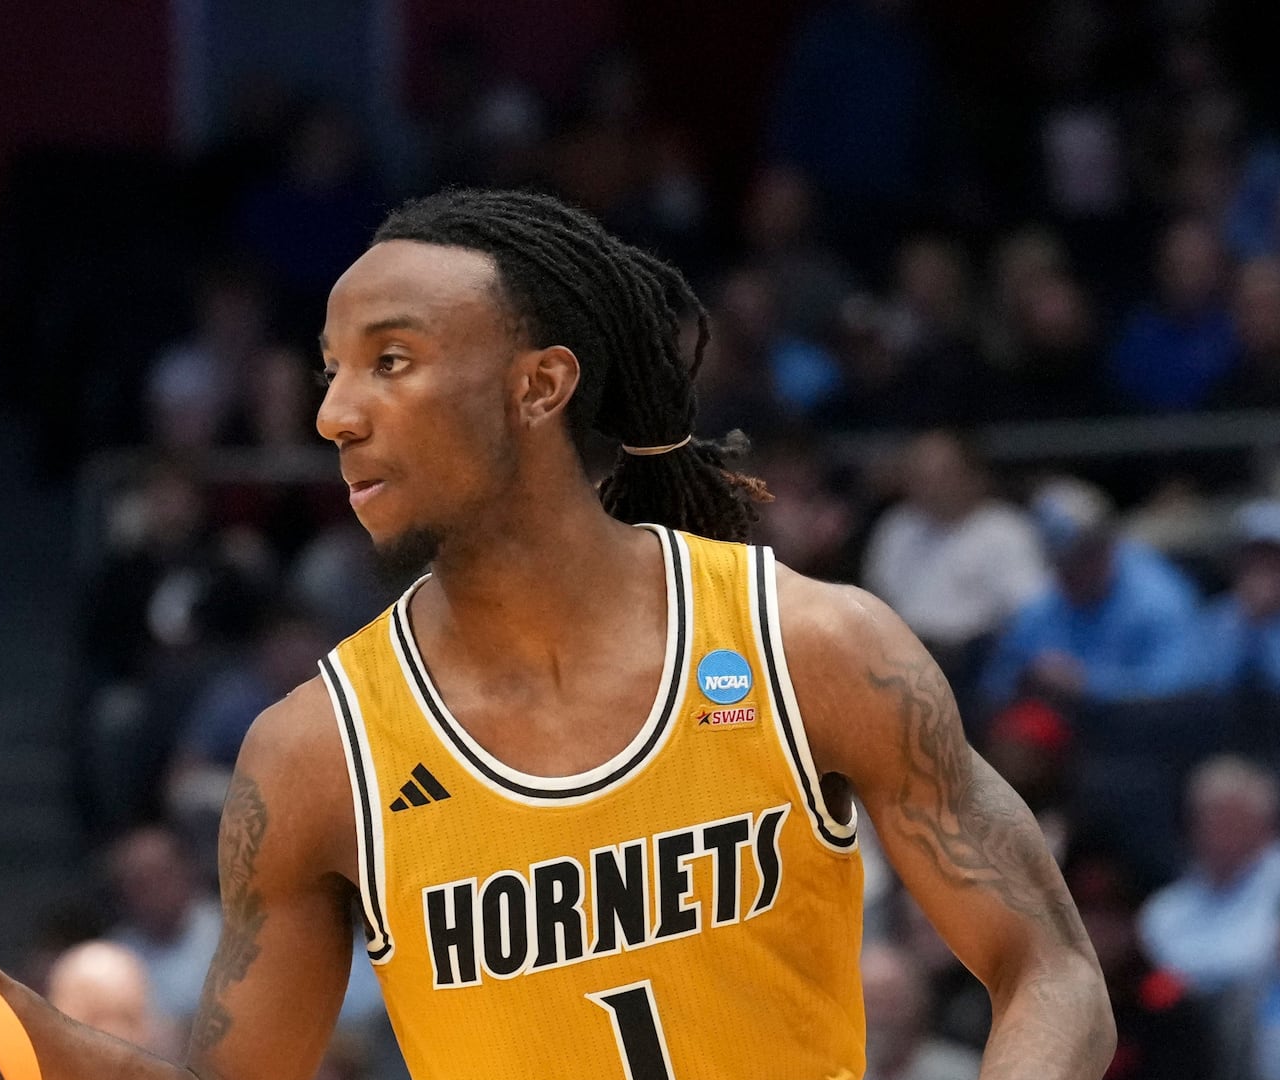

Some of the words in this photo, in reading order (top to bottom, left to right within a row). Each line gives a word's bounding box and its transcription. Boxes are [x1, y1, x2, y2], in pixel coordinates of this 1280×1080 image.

[704, 674, 750, 691] NCAA
[712, 707, 756, 725] SWAC
[422, 803, 791, 989] HORNETS
